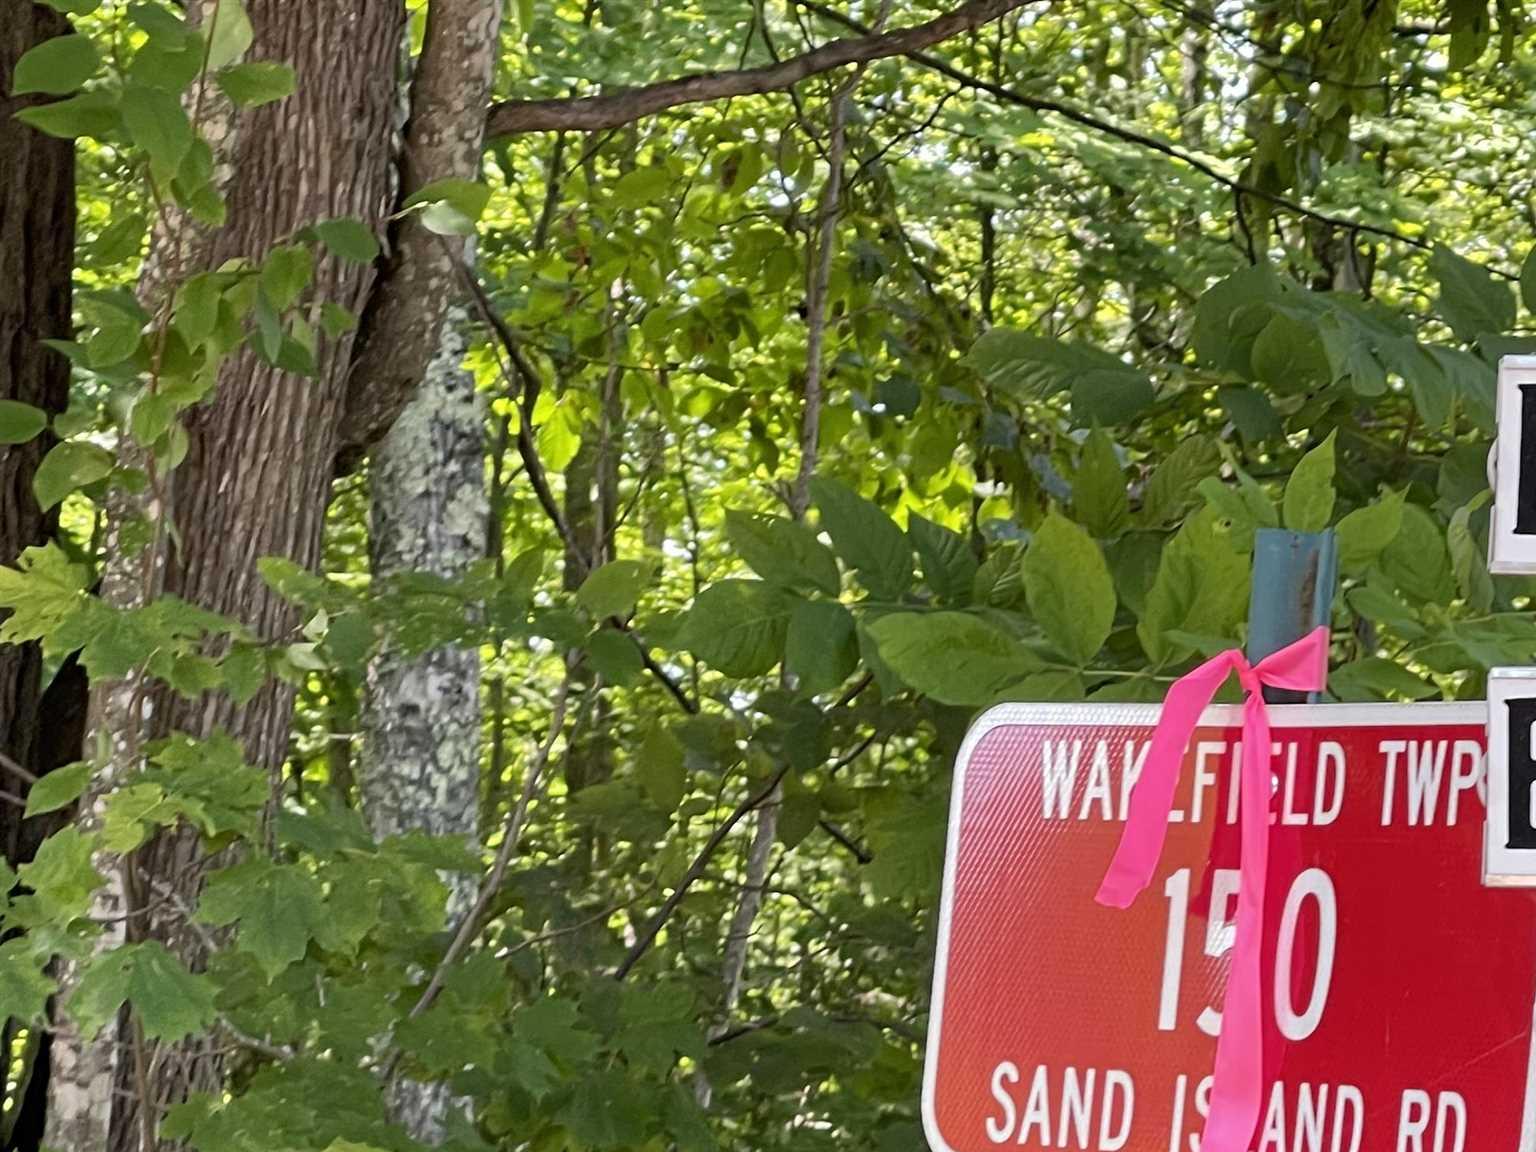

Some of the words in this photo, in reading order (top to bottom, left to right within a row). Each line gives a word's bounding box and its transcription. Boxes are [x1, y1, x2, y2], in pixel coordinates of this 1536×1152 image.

[1041, 739, 1346, 825] WAKFILD
[1379, 740, 1482, 826] TWP
[985, 1061, 1134, 1152] SAND
